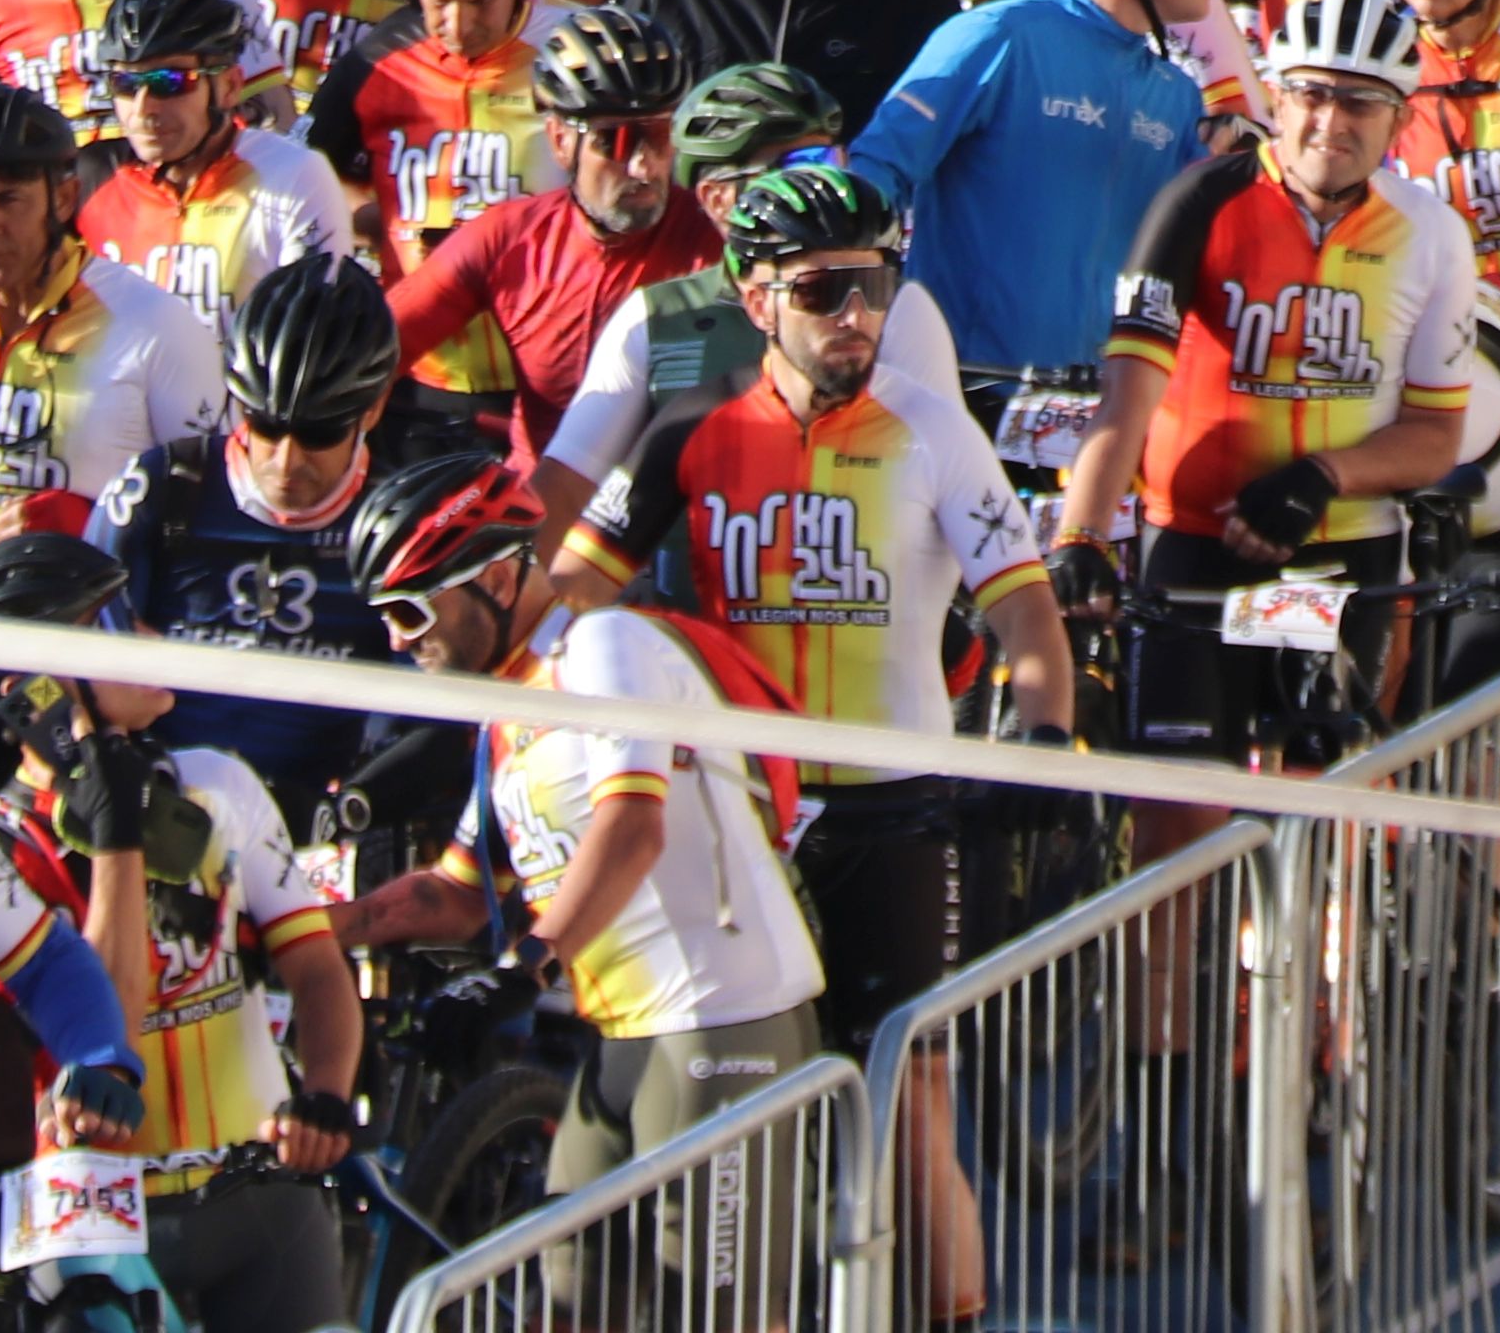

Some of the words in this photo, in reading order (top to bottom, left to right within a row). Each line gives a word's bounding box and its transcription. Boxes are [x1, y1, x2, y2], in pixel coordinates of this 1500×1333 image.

[1296, 336, 1384, 385] 24h
[1231, 379, 1250, 393] LA
[791, 546, 891, 603] 24h
[728, 607, 747, 623] LA
[809, 608, 847, 625] NOS
[852, 609, 891, 626] UNE
[48, 1176, 140, 1217] 7453
